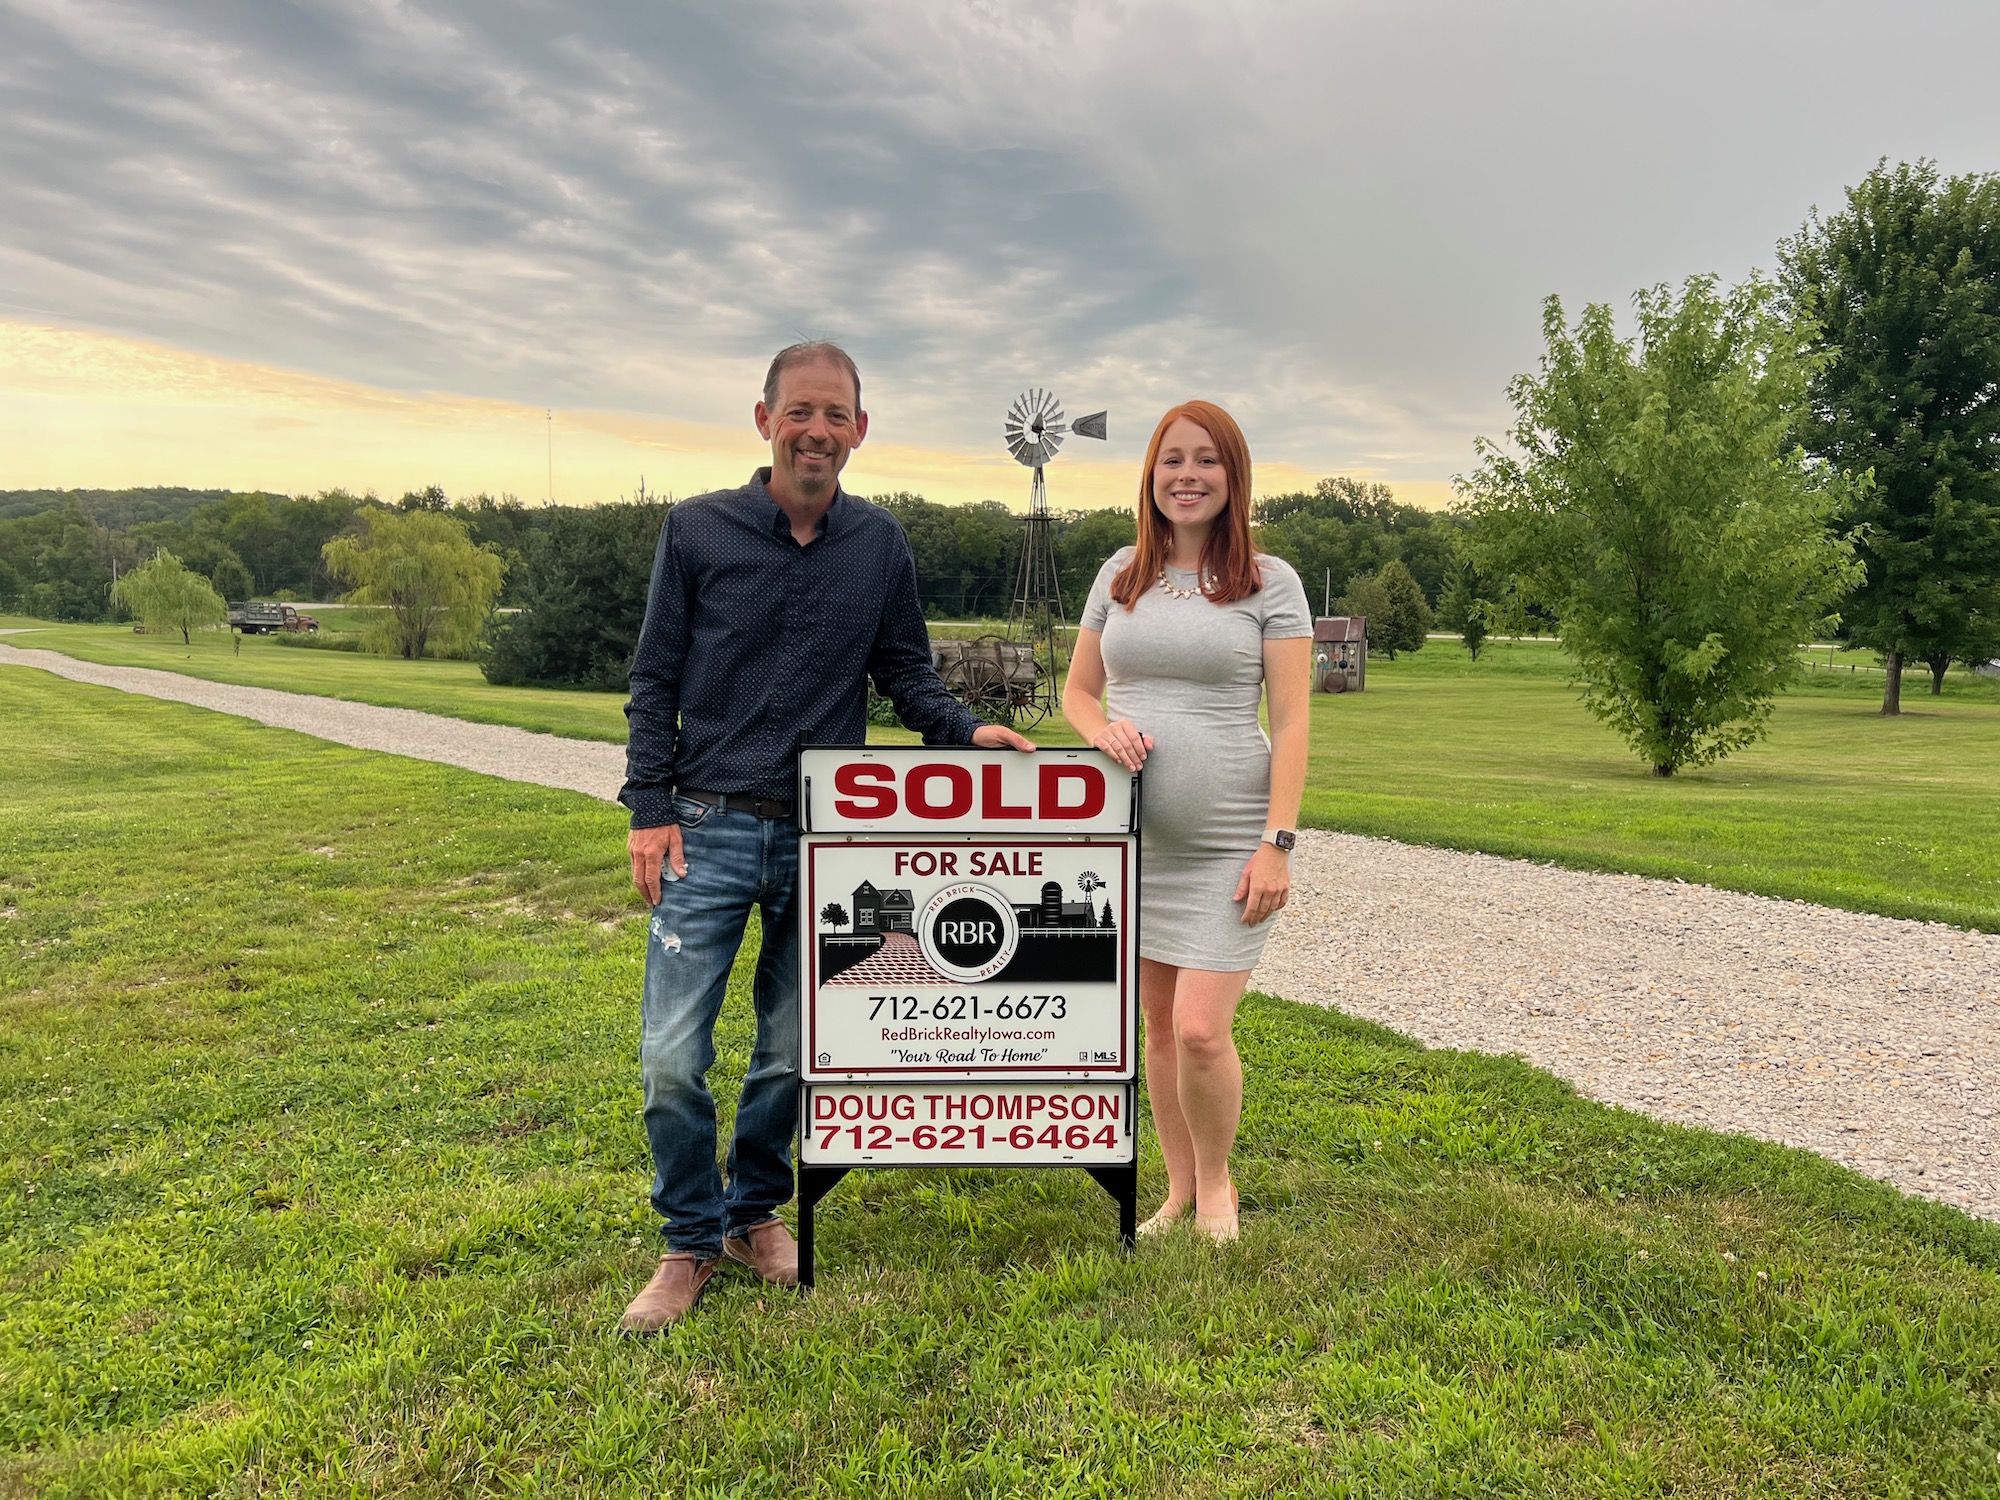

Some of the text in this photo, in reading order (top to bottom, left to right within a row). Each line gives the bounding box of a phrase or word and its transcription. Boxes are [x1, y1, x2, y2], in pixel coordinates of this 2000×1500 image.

[834, 763, 1106, 820] SOLD
[895, 851, 1043, 877] FOR SALE
[929, 886, 975, 912] RED BRICK
[941, 921, 997, 945] RBR
[980, 949, 1010, 977] REALTY
[869, 995, 1067, 1020] 712-621-6673
[881, 1026, 1056, 1044] RedBrickRealtyIowa.com
[936, 1048, 976, 1063] Road
[981, 1048, 999, 1062] To
[1094, 1051, 1117, 1060] MLS
[815, 1094, 1120, 1120] DOUG THOMPSON
[815, 1125, 1118, 1149] 712-621-6464
